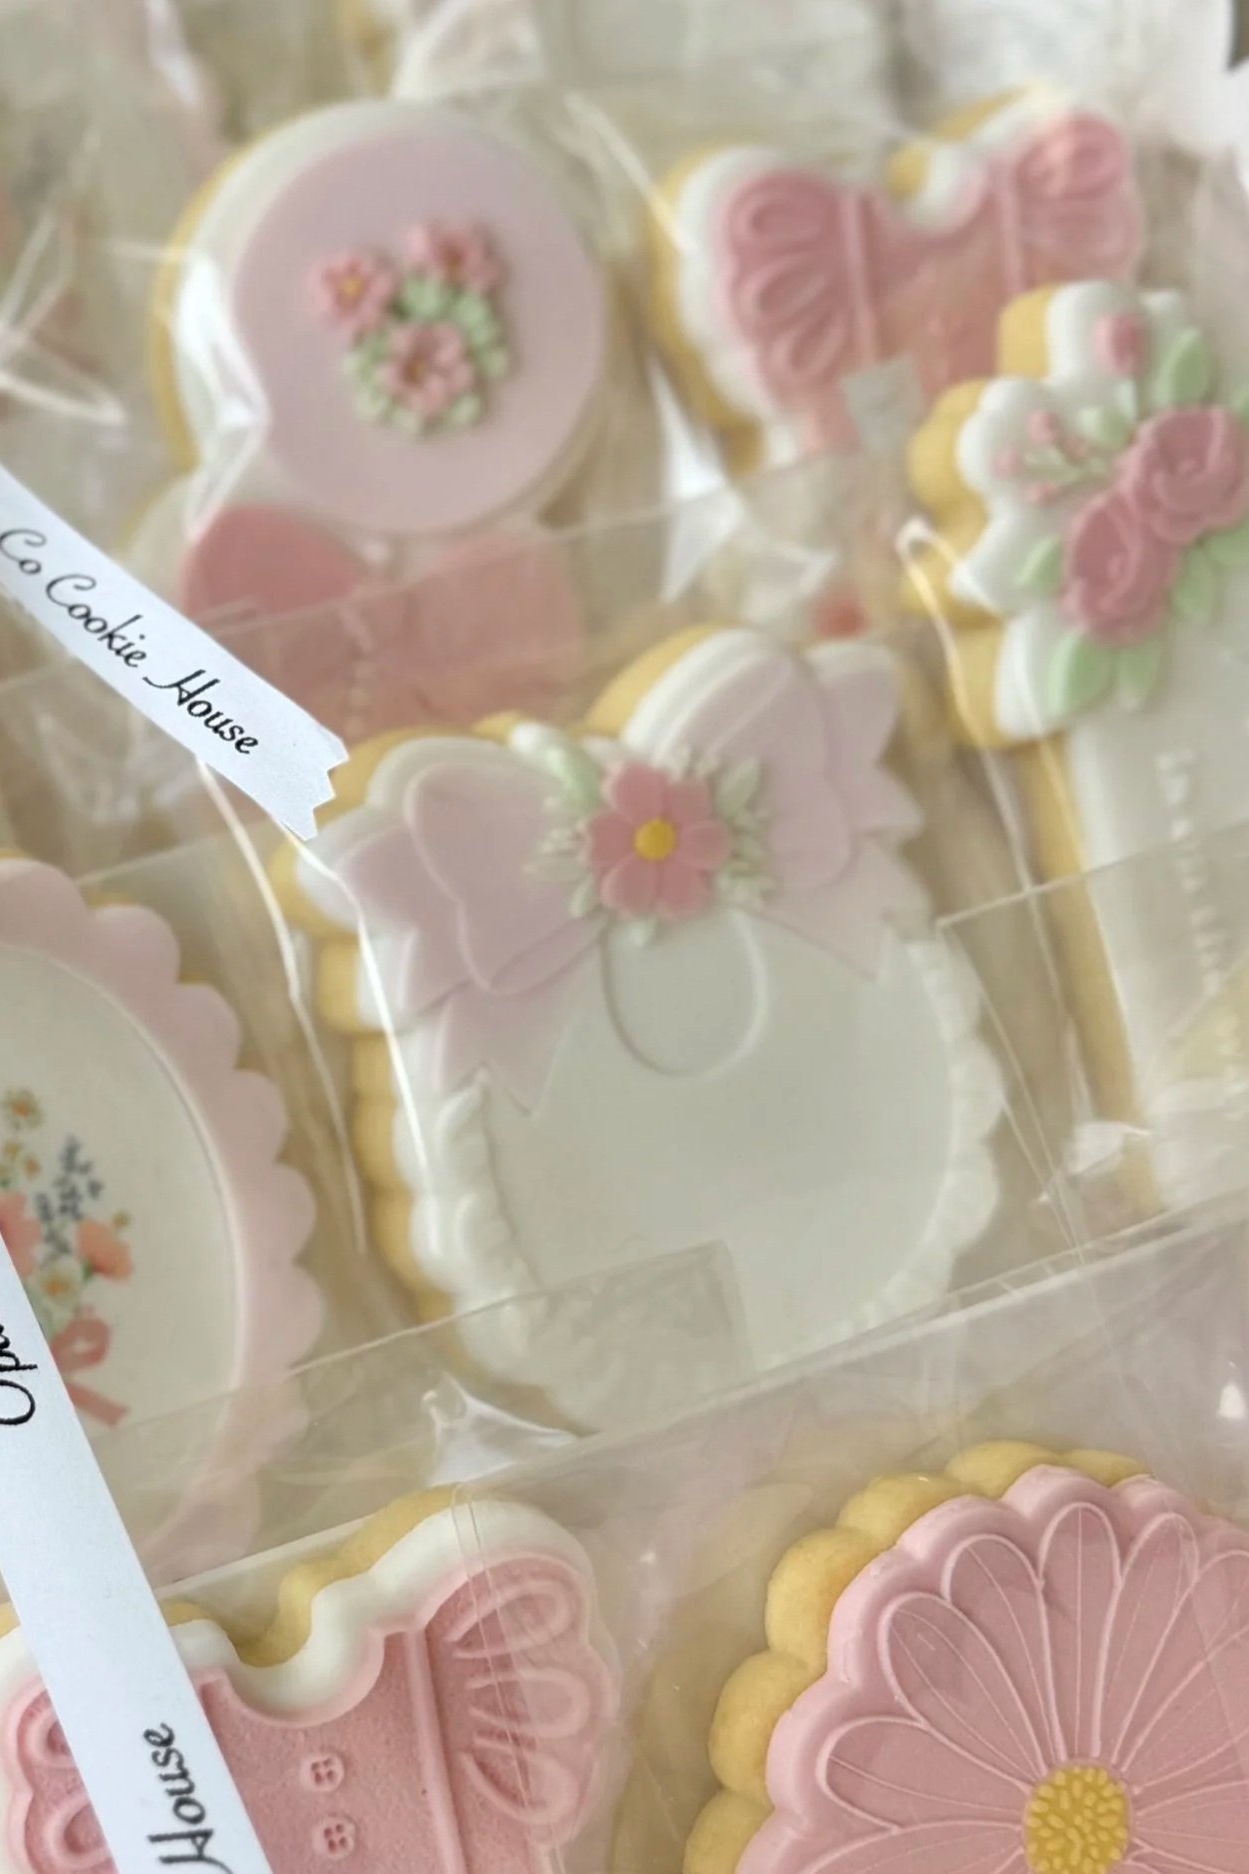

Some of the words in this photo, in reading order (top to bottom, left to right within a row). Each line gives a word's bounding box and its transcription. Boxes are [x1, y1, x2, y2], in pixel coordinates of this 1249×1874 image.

[46, 574, 148, 667] Cookie
[143, 670, 259, 755] House
[143, 1723, 234, 1874] House
